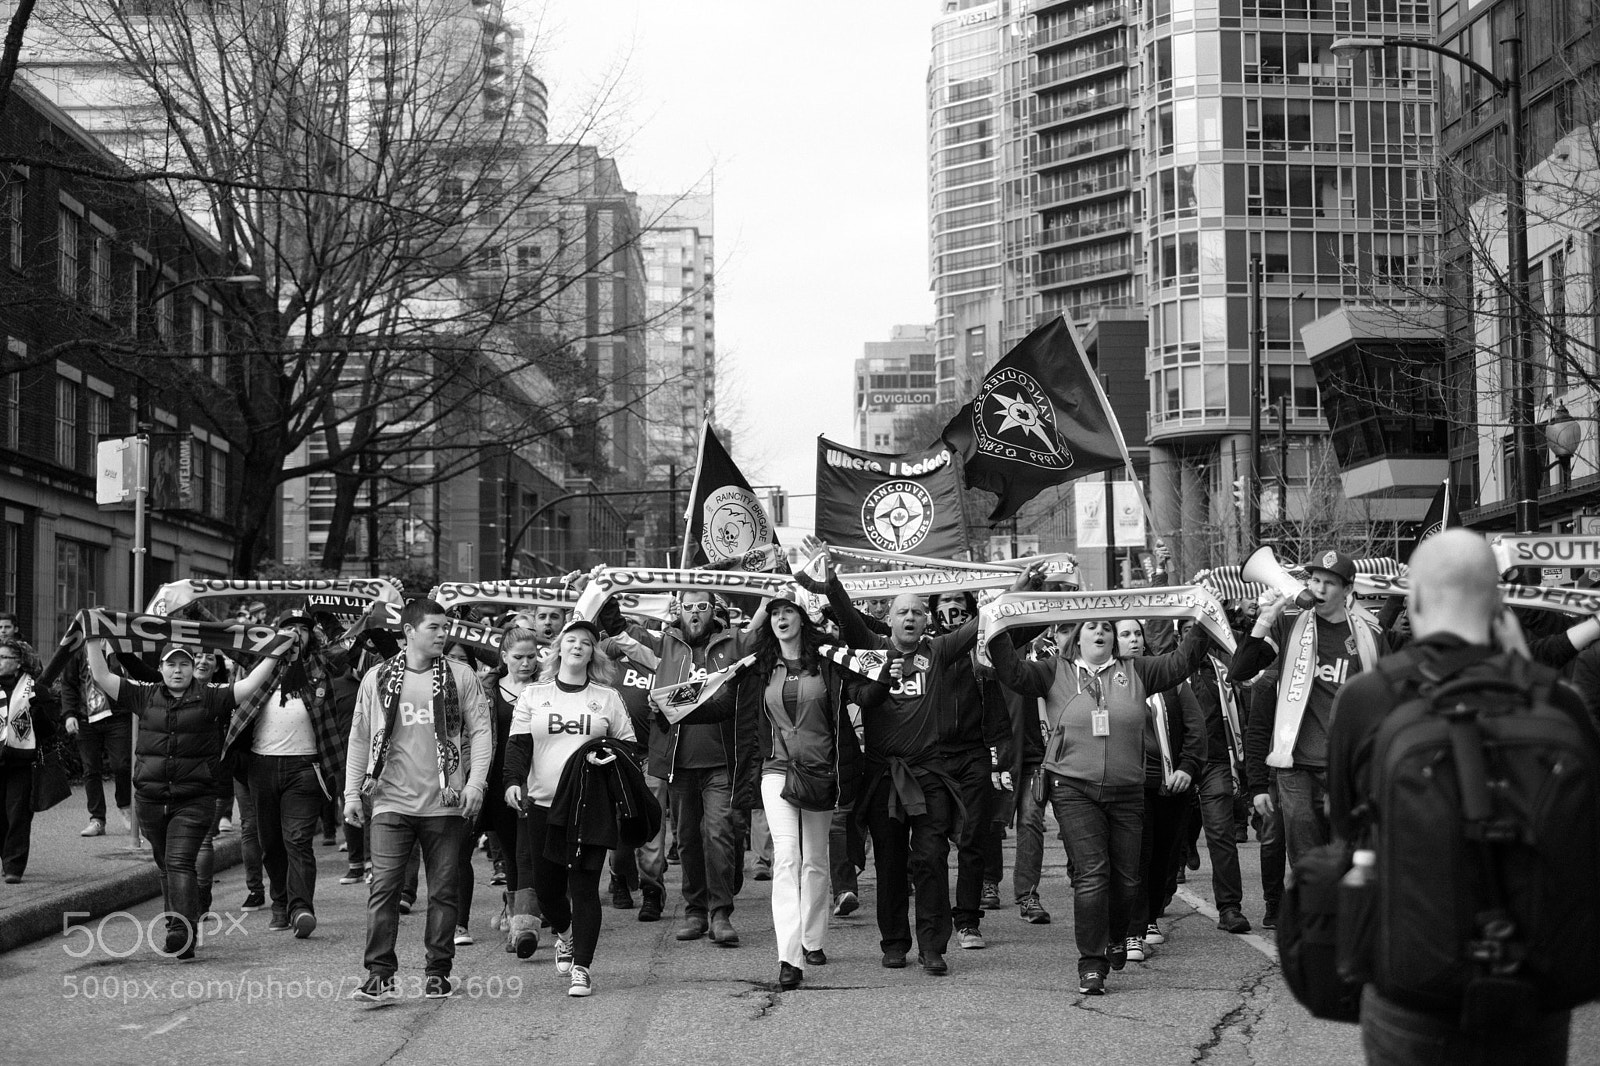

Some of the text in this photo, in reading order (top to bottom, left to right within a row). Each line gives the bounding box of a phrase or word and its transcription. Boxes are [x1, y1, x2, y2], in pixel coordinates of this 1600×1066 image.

[826, 449, 951, 476] Where I belong
[867, 483, 928, 508] VANCOUVER
[752, 504, 768, 542] BRIGADE
[867, 520, 929, 550] SOUTH SIDERS
[189, 579, 384, 598] SOUTHSIDERS
[842, 578, 888, 591] OME
[988, 599, 1050, 622] HOME
[1133, 593, 1196, 609] NEAR
[623, 668, 656, 690] Bell
[400, 700, 435, 726] Bel
[548, 713, 592, 735] Bell
